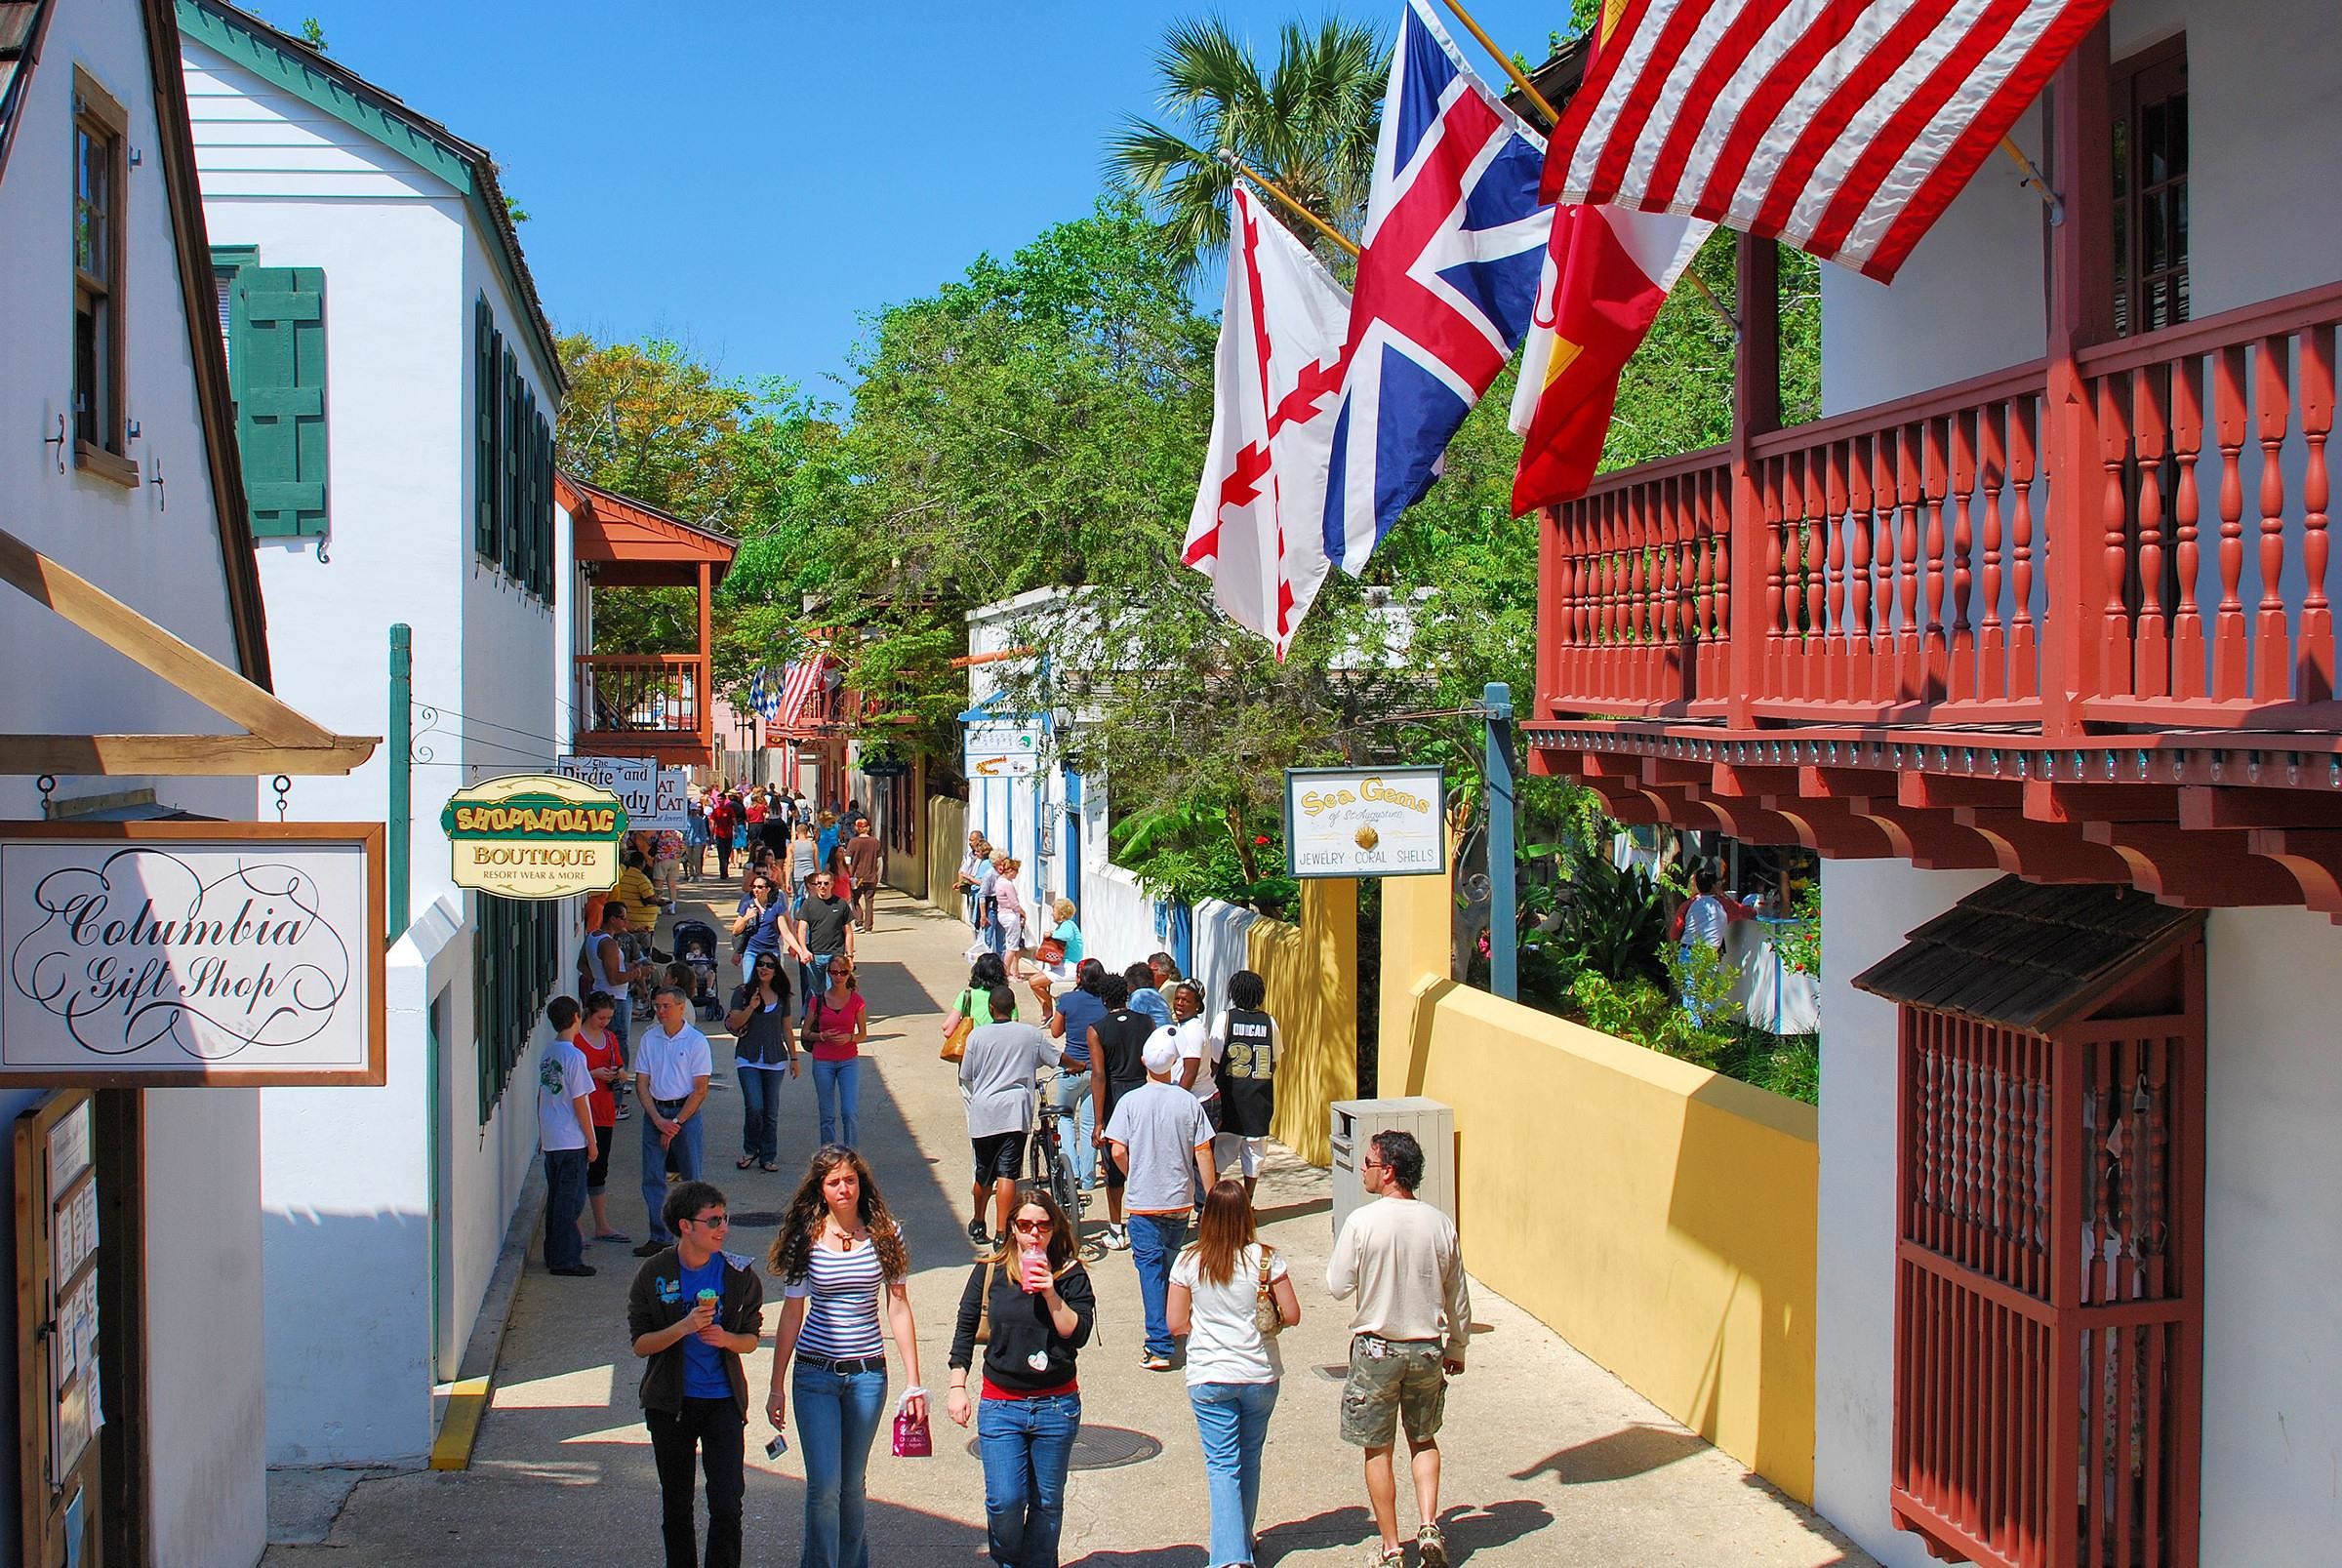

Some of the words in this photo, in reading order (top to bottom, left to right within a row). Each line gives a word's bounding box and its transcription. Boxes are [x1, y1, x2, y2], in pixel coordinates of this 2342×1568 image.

[625, 769, 648, 782] and
[657, 780, 675, 793] AT
[620, 789, 650, 814] dy
[657, 794, 684, 812] CAT
[1301, 788, 1356, 818] Sea
[1359, 776, 1431, 815] Gems
[455, 806, 617, 833] SHOPAHOLIC
[1328, 810, 1341, 828] of
[472, 846, 596, 868] BOUTIQUE
[1299, 852, 1346, 866] JEWELRY
[1354, 850, 1388, 864] CORAL
[1397, 849, 1434, 864] SHELLS
[483, 870, 518, 880] RESORT
[520, 870, 545, 880] WEAR
[548, 870, 555, 879] &
[557, 871, 586, 880] MORE
[64, 894, 304, 946] Columbia
[86, 955, 171, 1017] Gift
[179, 955, 277, 1016] Shop
[1232, 1023, 1268, 1038] DUNCAN
[1226, 1041, 1272, 1080] 21
